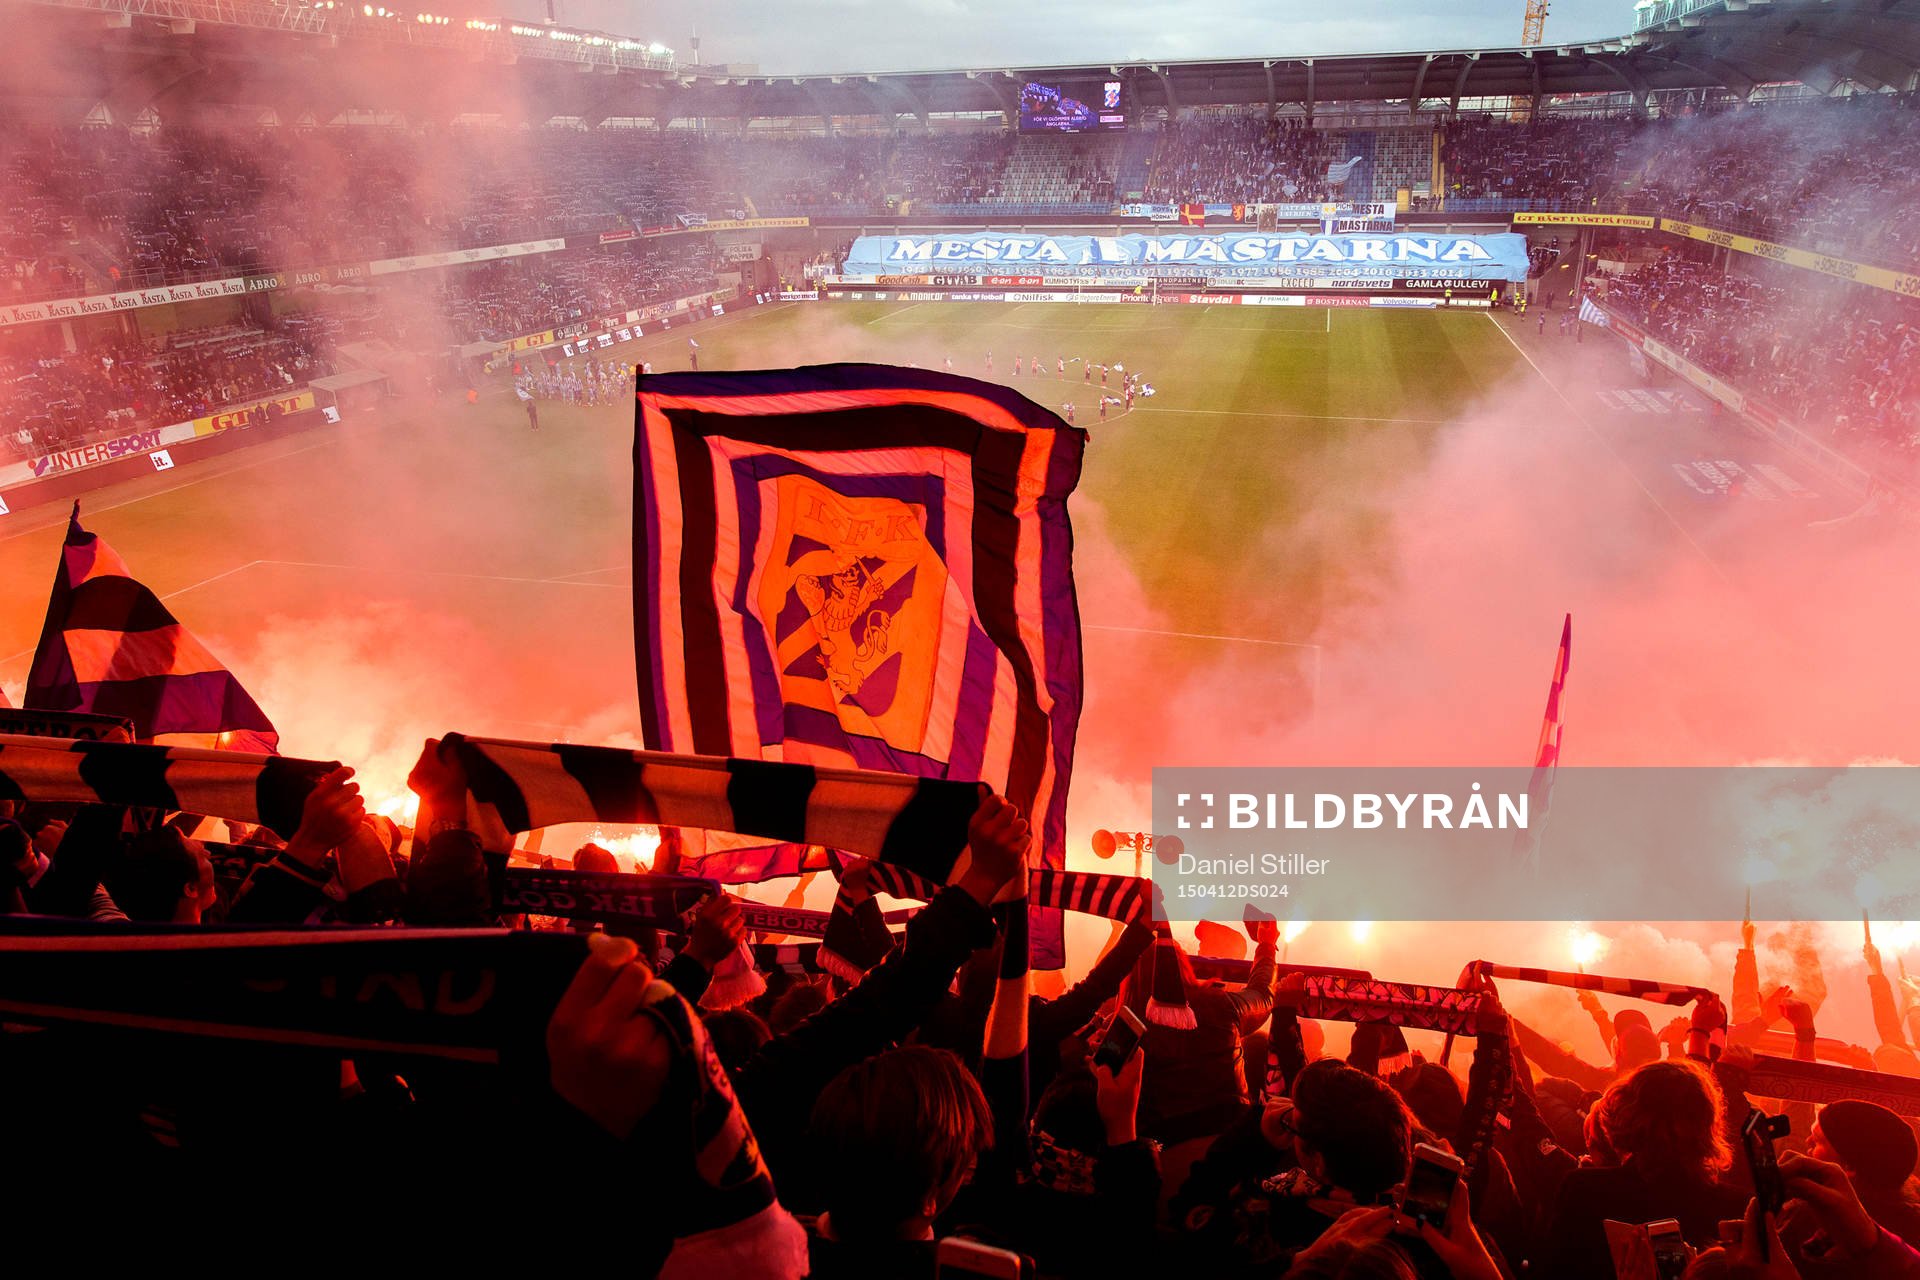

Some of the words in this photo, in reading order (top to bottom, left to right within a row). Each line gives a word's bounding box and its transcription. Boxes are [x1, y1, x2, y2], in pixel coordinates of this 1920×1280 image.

[1352, 204, 1385, 215] MESTA
[888, 238, 1069, 262] MESTA
[222, 284, 244, 294] RASTA
[1331, 279, 1391, 288] nordsvets
[1405, 279, 1443, 288] GAMLA
[1453, 280, 1489, 288] ULLEVI
[169, 291, 193, 301] RASTA
[197, 287, 219, 297] RASTA
[1021, 293, 1054, 301] Nilfisk
[112, 298, 138, 309] RASTA
[141, 294, 166, 305] RASTA
[1189, 294, 1233, 304] Stavdal
[48, 306, 77, 317] RASTA
[80, 302, 108, 313] RASTA
[211, 410, 250, 430] GT
[51, 429, 161, 470] INTERSPORT
